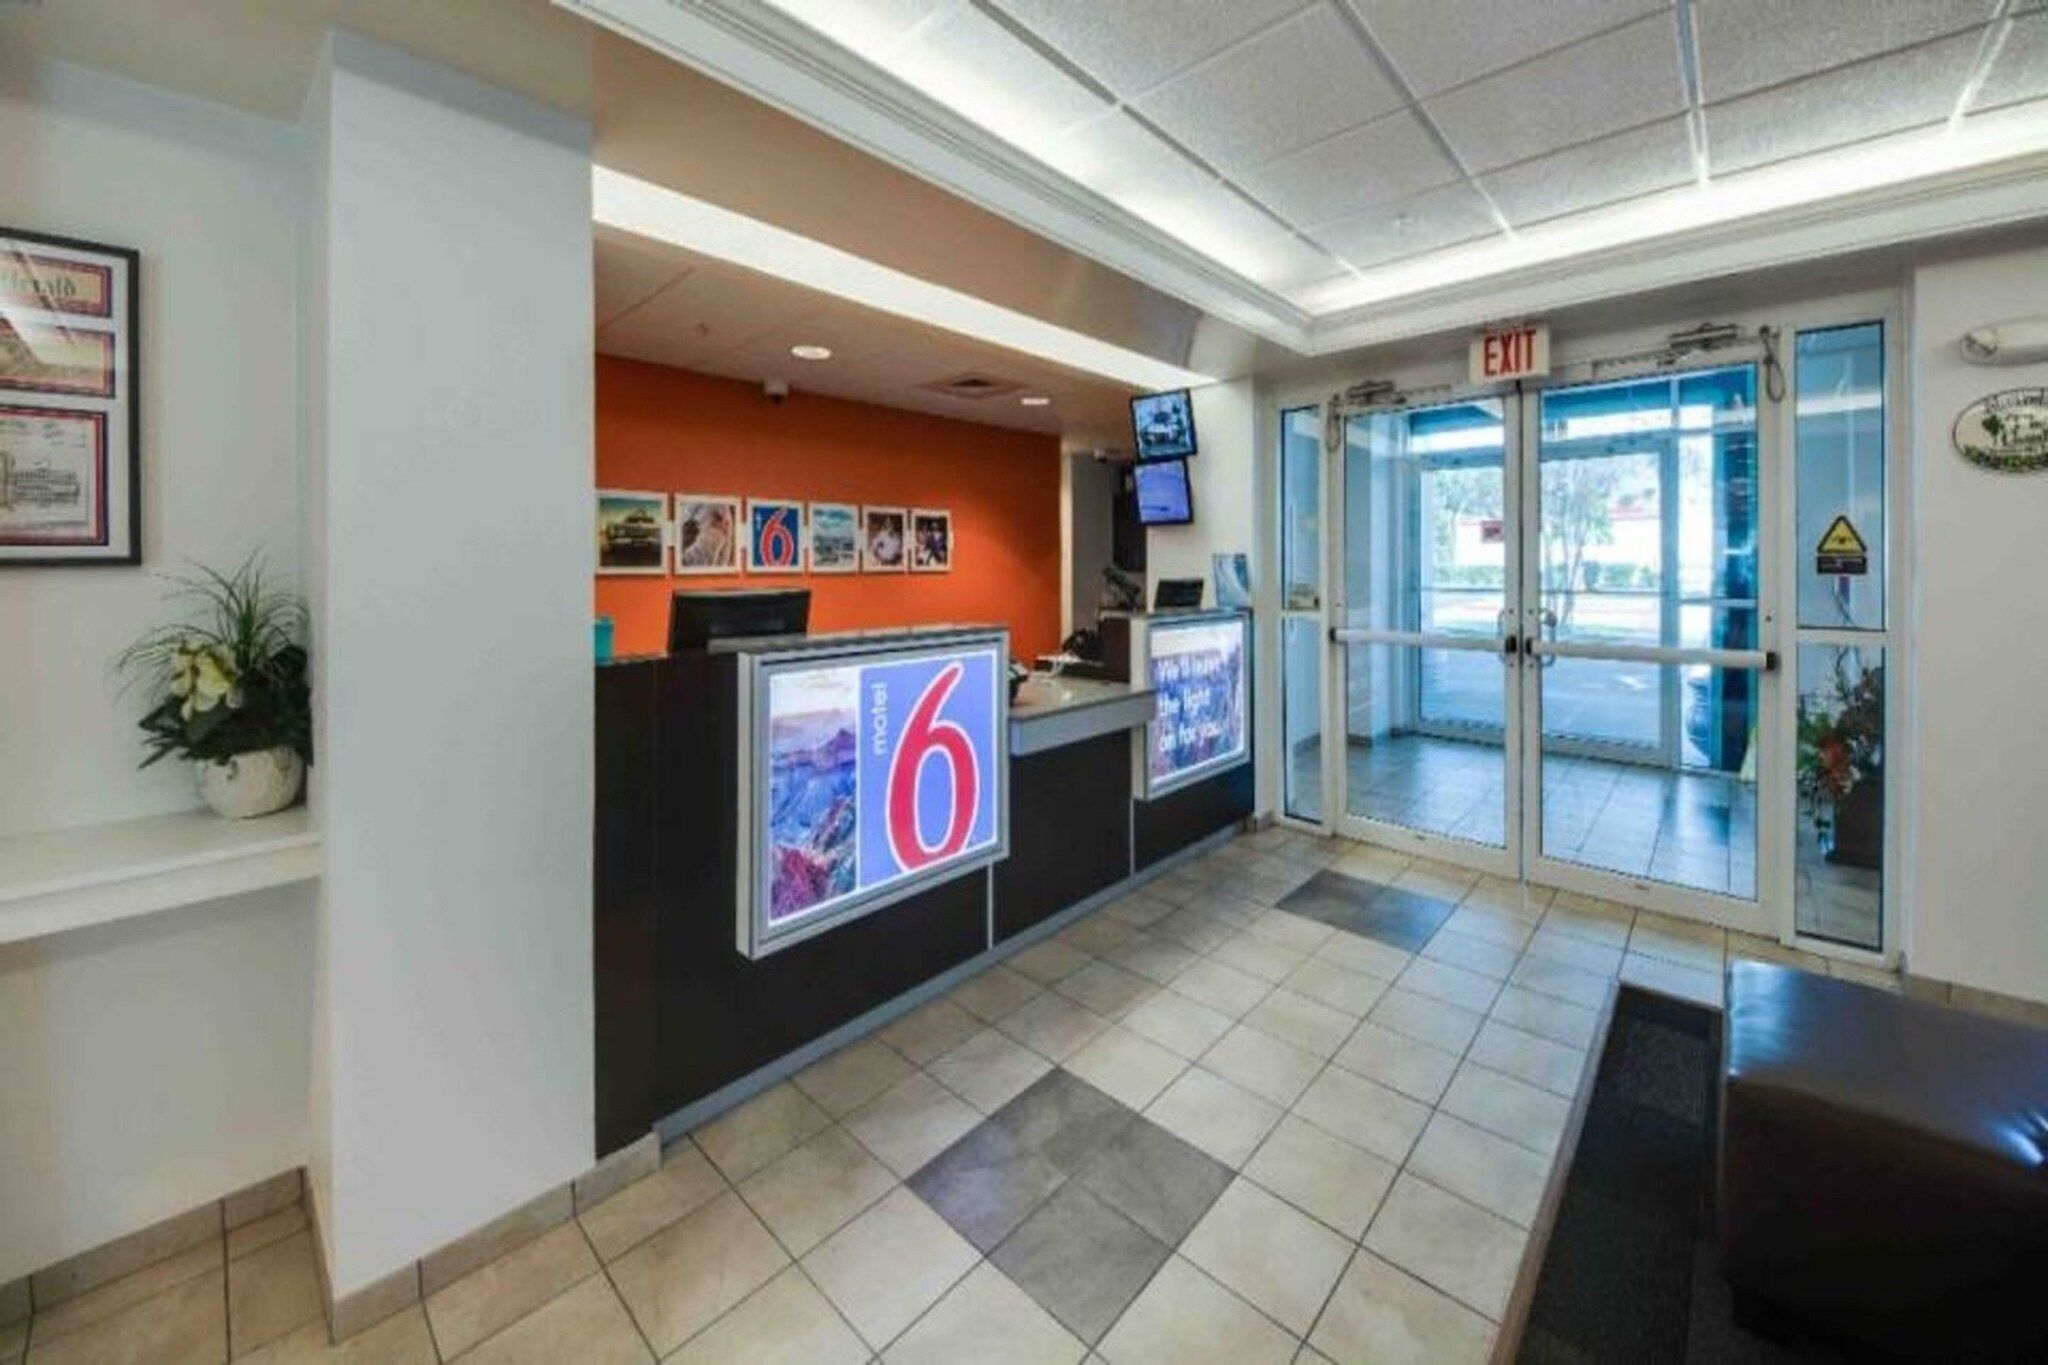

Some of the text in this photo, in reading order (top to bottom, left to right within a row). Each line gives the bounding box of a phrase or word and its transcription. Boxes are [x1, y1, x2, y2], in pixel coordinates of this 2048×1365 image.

[1484, 328, 1536, 376] EXIT
[759, 508, 794, 566] 6
[870, 682, 888, 754] motel
[885, 661, 980, 872] 6
